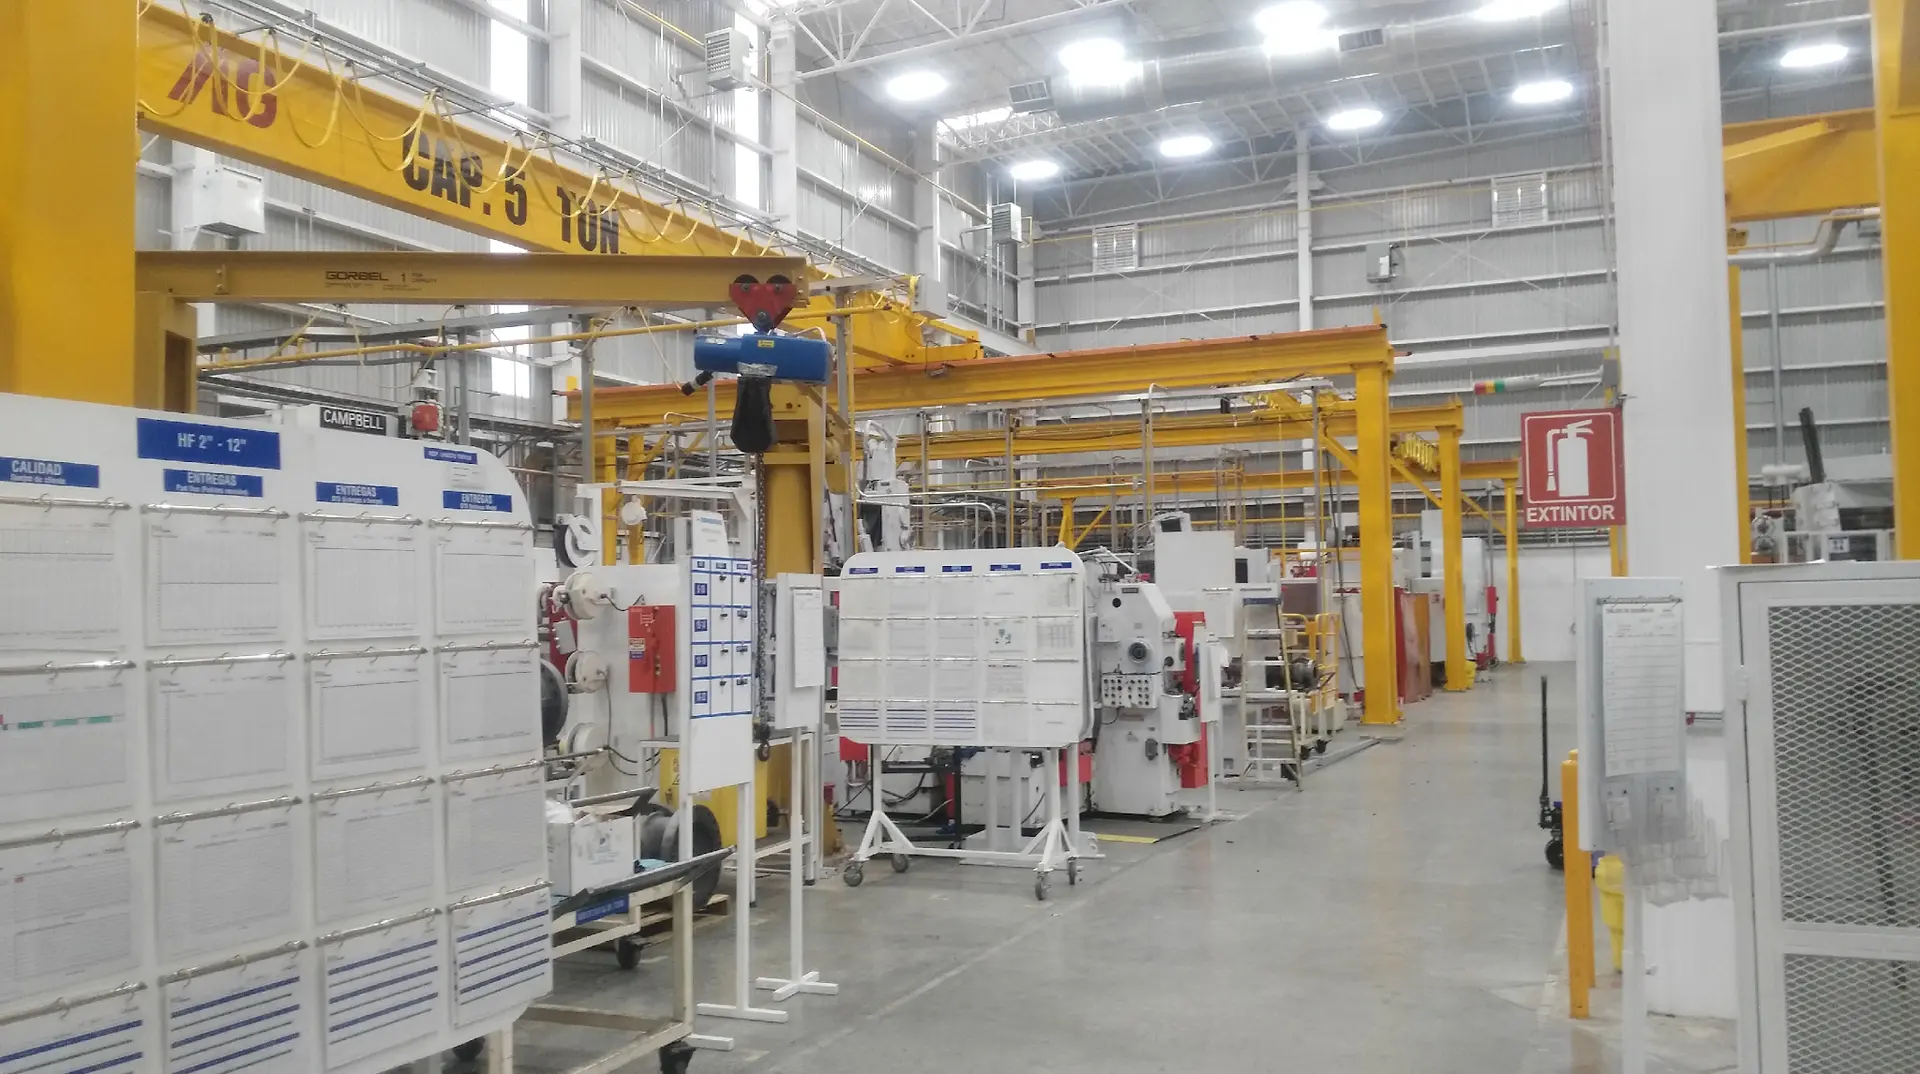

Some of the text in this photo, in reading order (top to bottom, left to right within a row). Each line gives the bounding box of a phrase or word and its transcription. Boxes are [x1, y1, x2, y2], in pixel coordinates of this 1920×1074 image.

[402, 127, 491, 216] CAP.
[504, 165, 528, 227] 5
[325, 270, 406, 282] GORBEL 1
[323, 409, 384, 430] CAMPBELL
[177, 432, 196, 448] HF
[11, 460, 62, 476] CALIDAD
[187, 472, 237, 487] ENTREGAS
[335, 485, 377, 498] ENTREGAS
[461, 493, 493, 505] ENTREGAS
[1526, 504, 1615, 523] EXTINTOR
